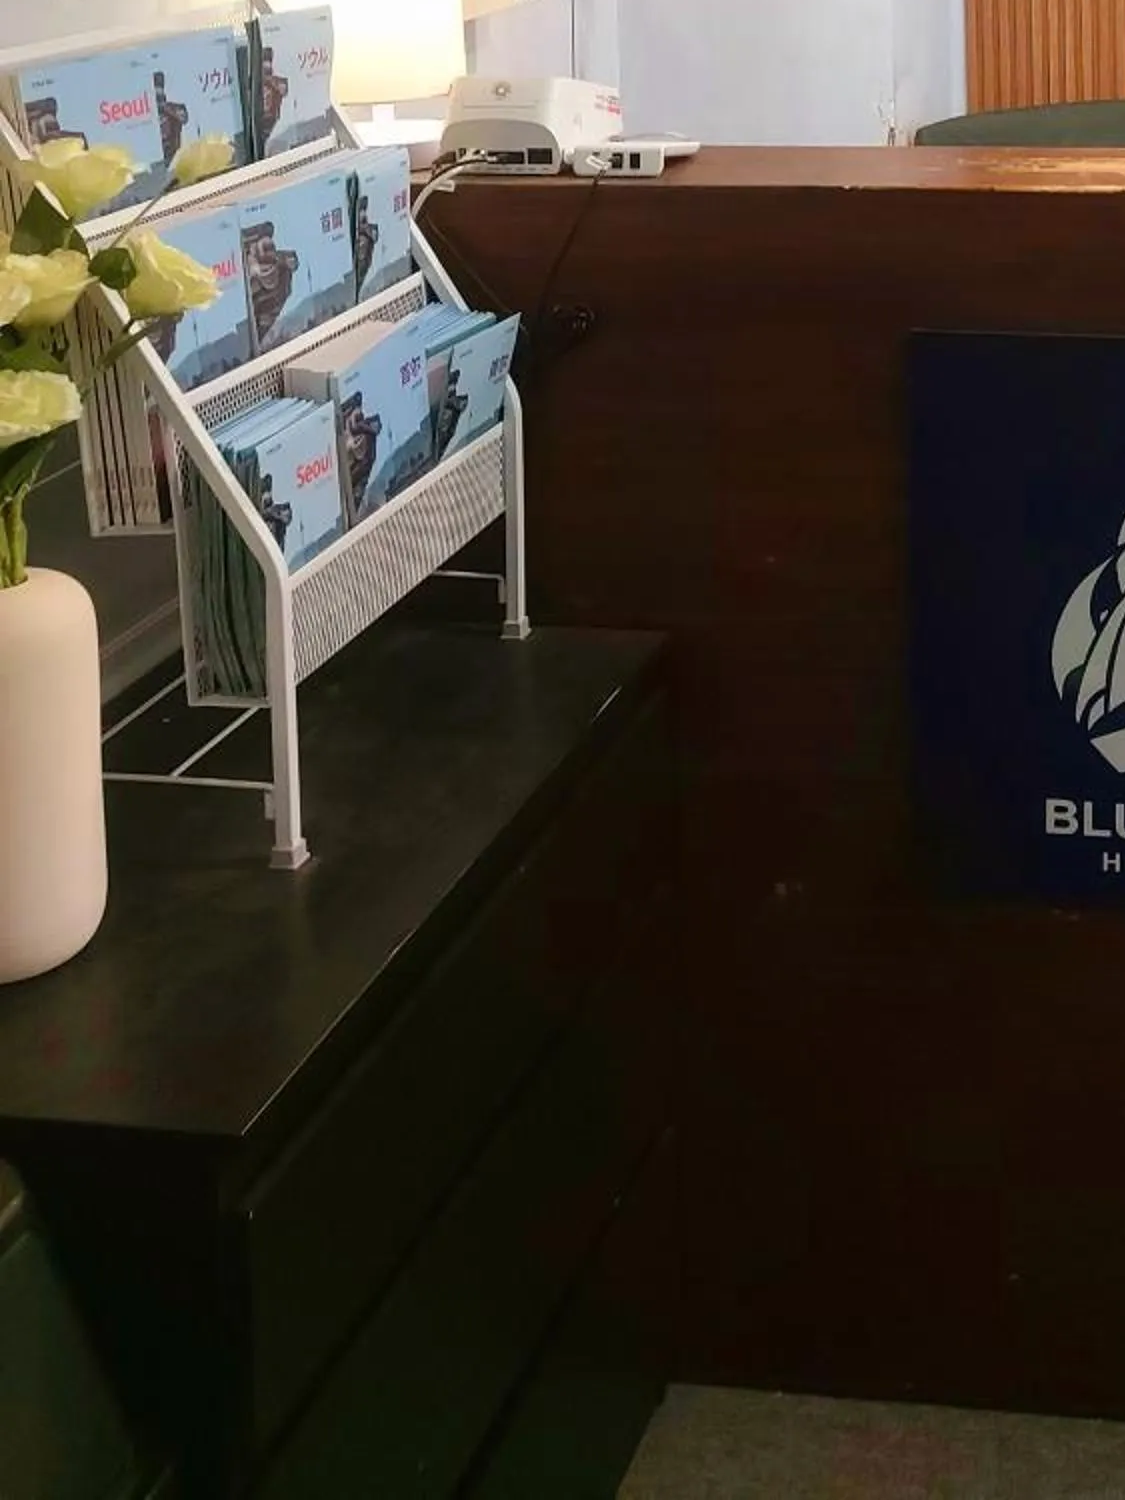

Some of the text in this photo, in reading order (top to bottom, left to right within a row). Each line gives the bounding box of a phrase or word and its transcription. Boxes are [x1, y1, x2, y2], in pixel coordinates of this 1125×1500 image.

[99, 91, 151, 125] Seoul
[211, 252, 238, 278] oul
[296, 446, 334, 489] Seoul
